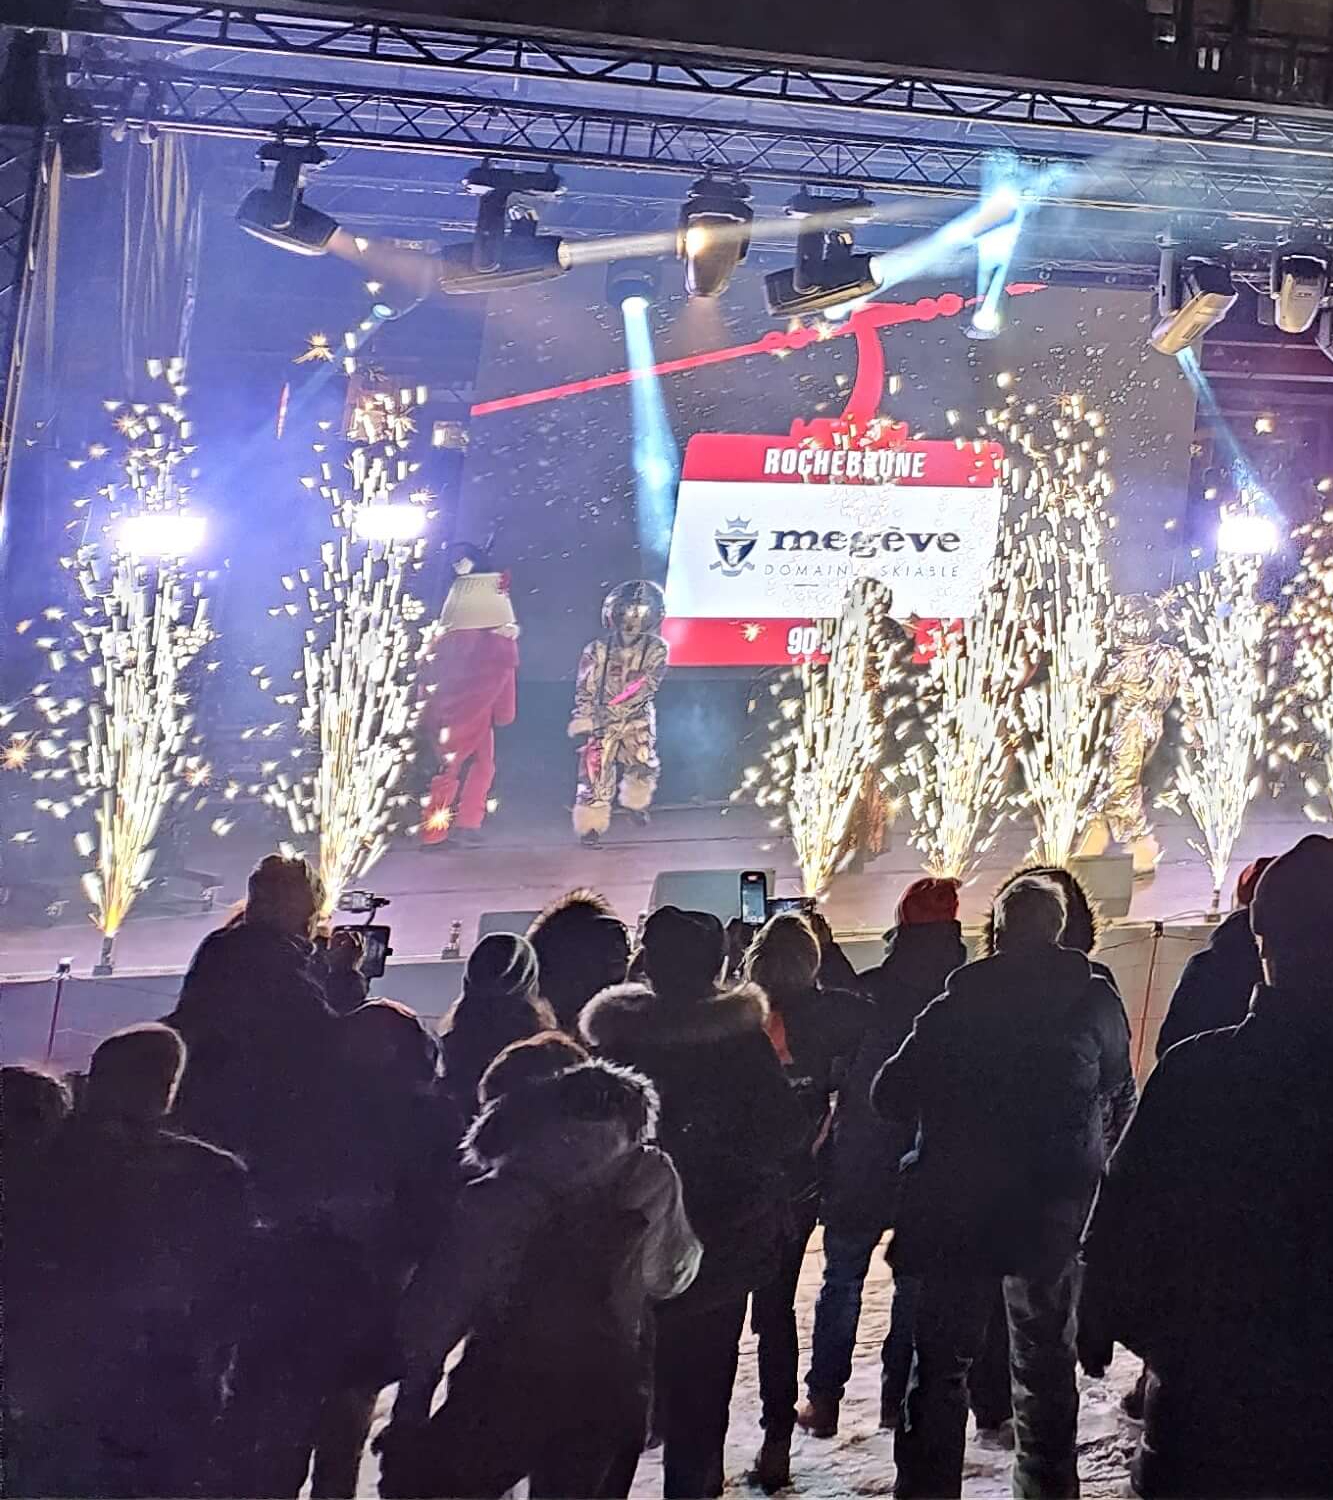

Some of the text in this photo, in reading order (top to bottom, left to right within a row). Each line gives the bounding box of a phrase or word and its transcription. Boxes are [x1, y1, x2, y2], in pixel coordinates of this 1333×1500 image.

[764, 448, 927, 478] ROCHEBRUNE
[768, 526, 961, 558] megève
[764, 564, 857, 577] DOMAIN
[786, 627, 818, 655] 90
